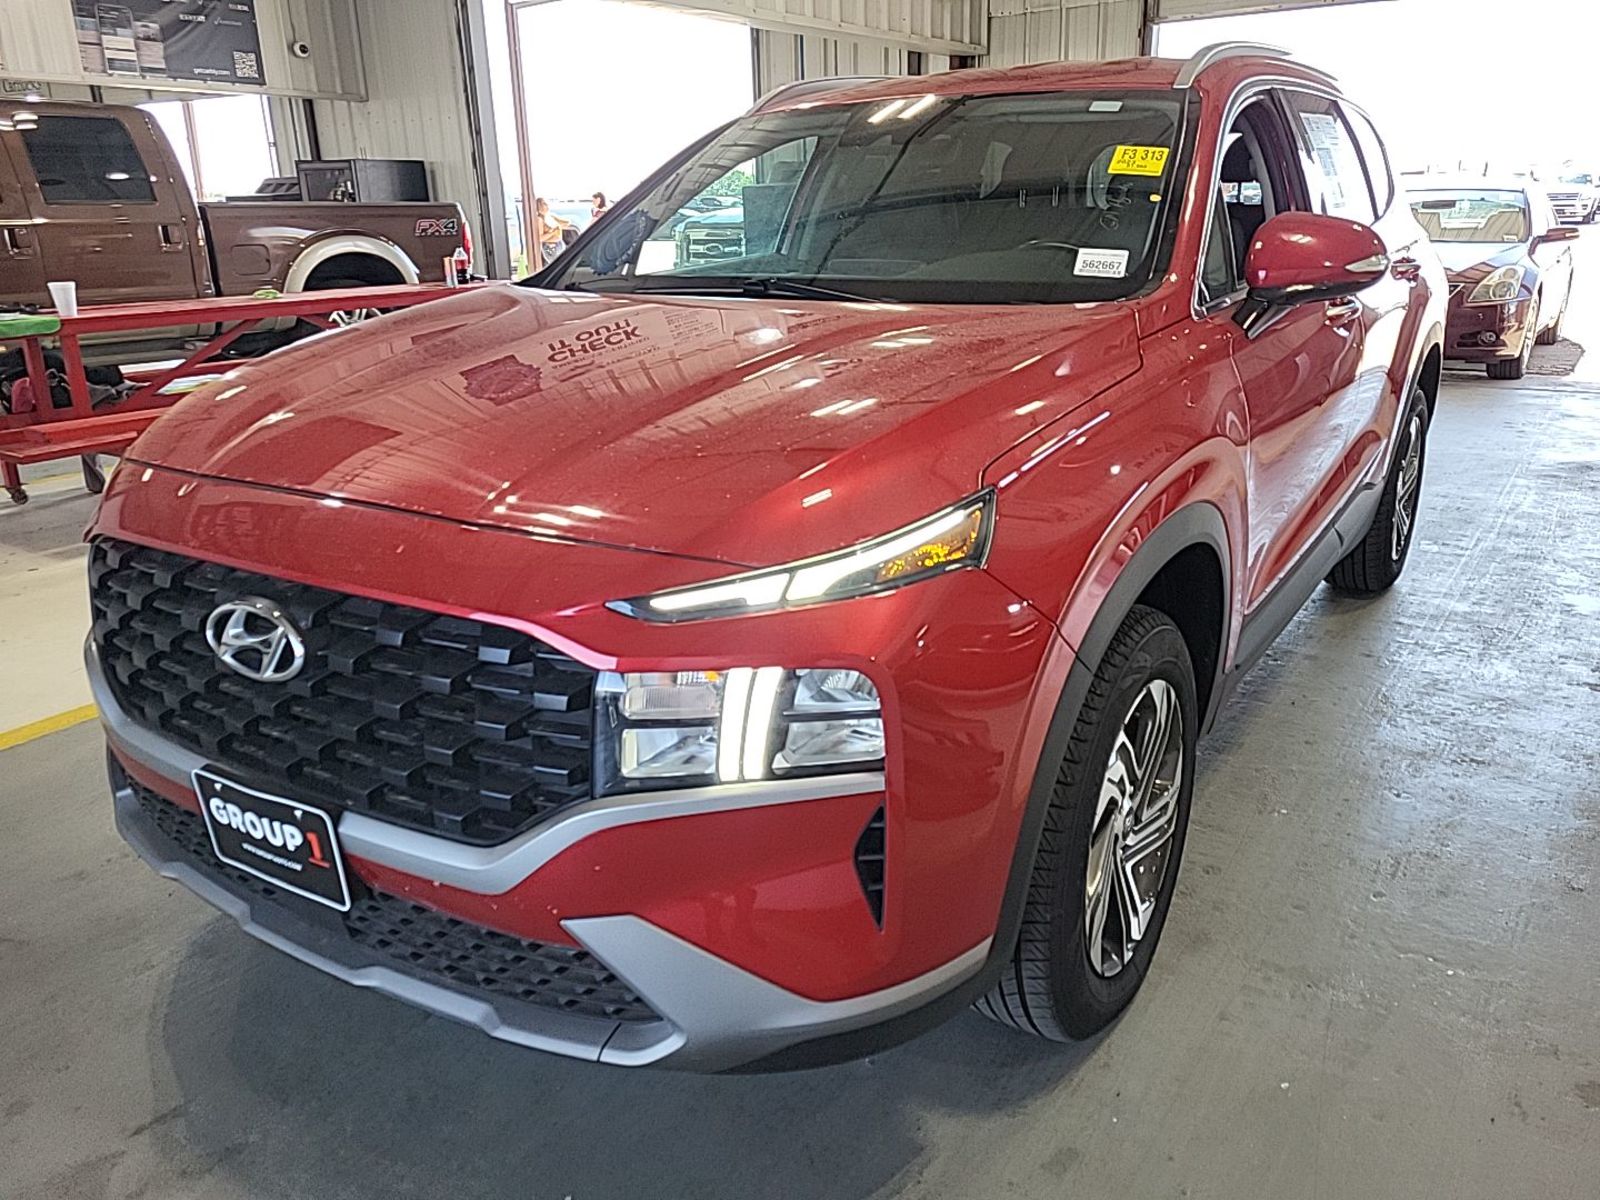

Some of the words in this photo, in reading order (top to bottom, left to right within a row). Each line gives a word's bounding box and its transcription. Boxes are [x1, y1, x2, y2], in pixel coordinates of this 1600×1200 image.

[1121, 148, 1137, 160] F3
[1141, 149, 1165, 161] 313
[415, 218, 457, 233] FX4
[1081, 259, 1122, 271] 562667
